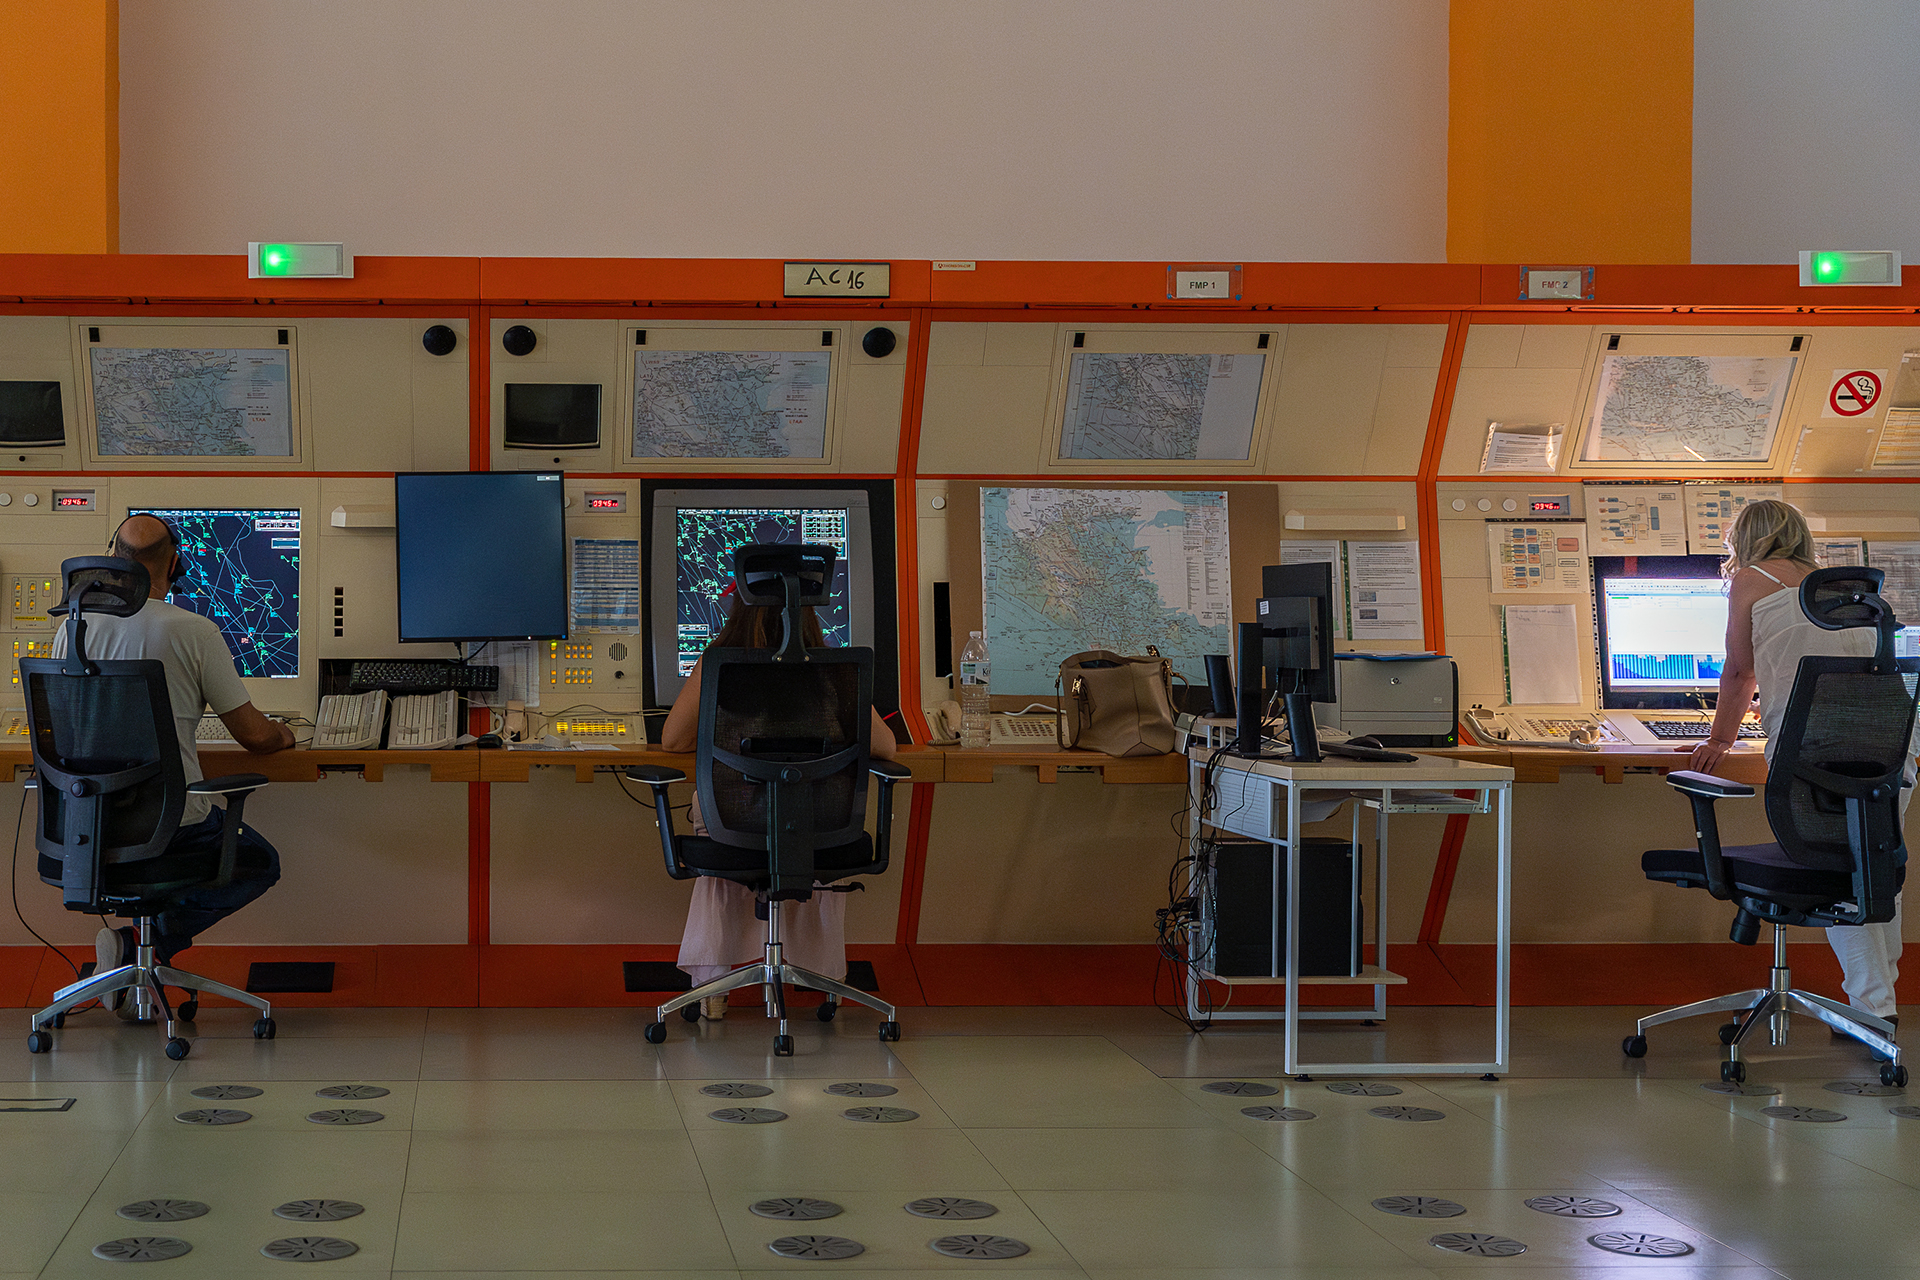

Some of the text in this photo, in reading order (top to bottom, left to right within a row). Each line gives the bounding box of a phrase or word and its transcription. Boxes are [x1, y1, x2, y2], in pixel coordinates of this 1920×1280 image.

[804, 267, 865, 290] AC 16
[1189, 281, 1215, 290] FMP 1
[1562, 281, 1568, 289] 2
